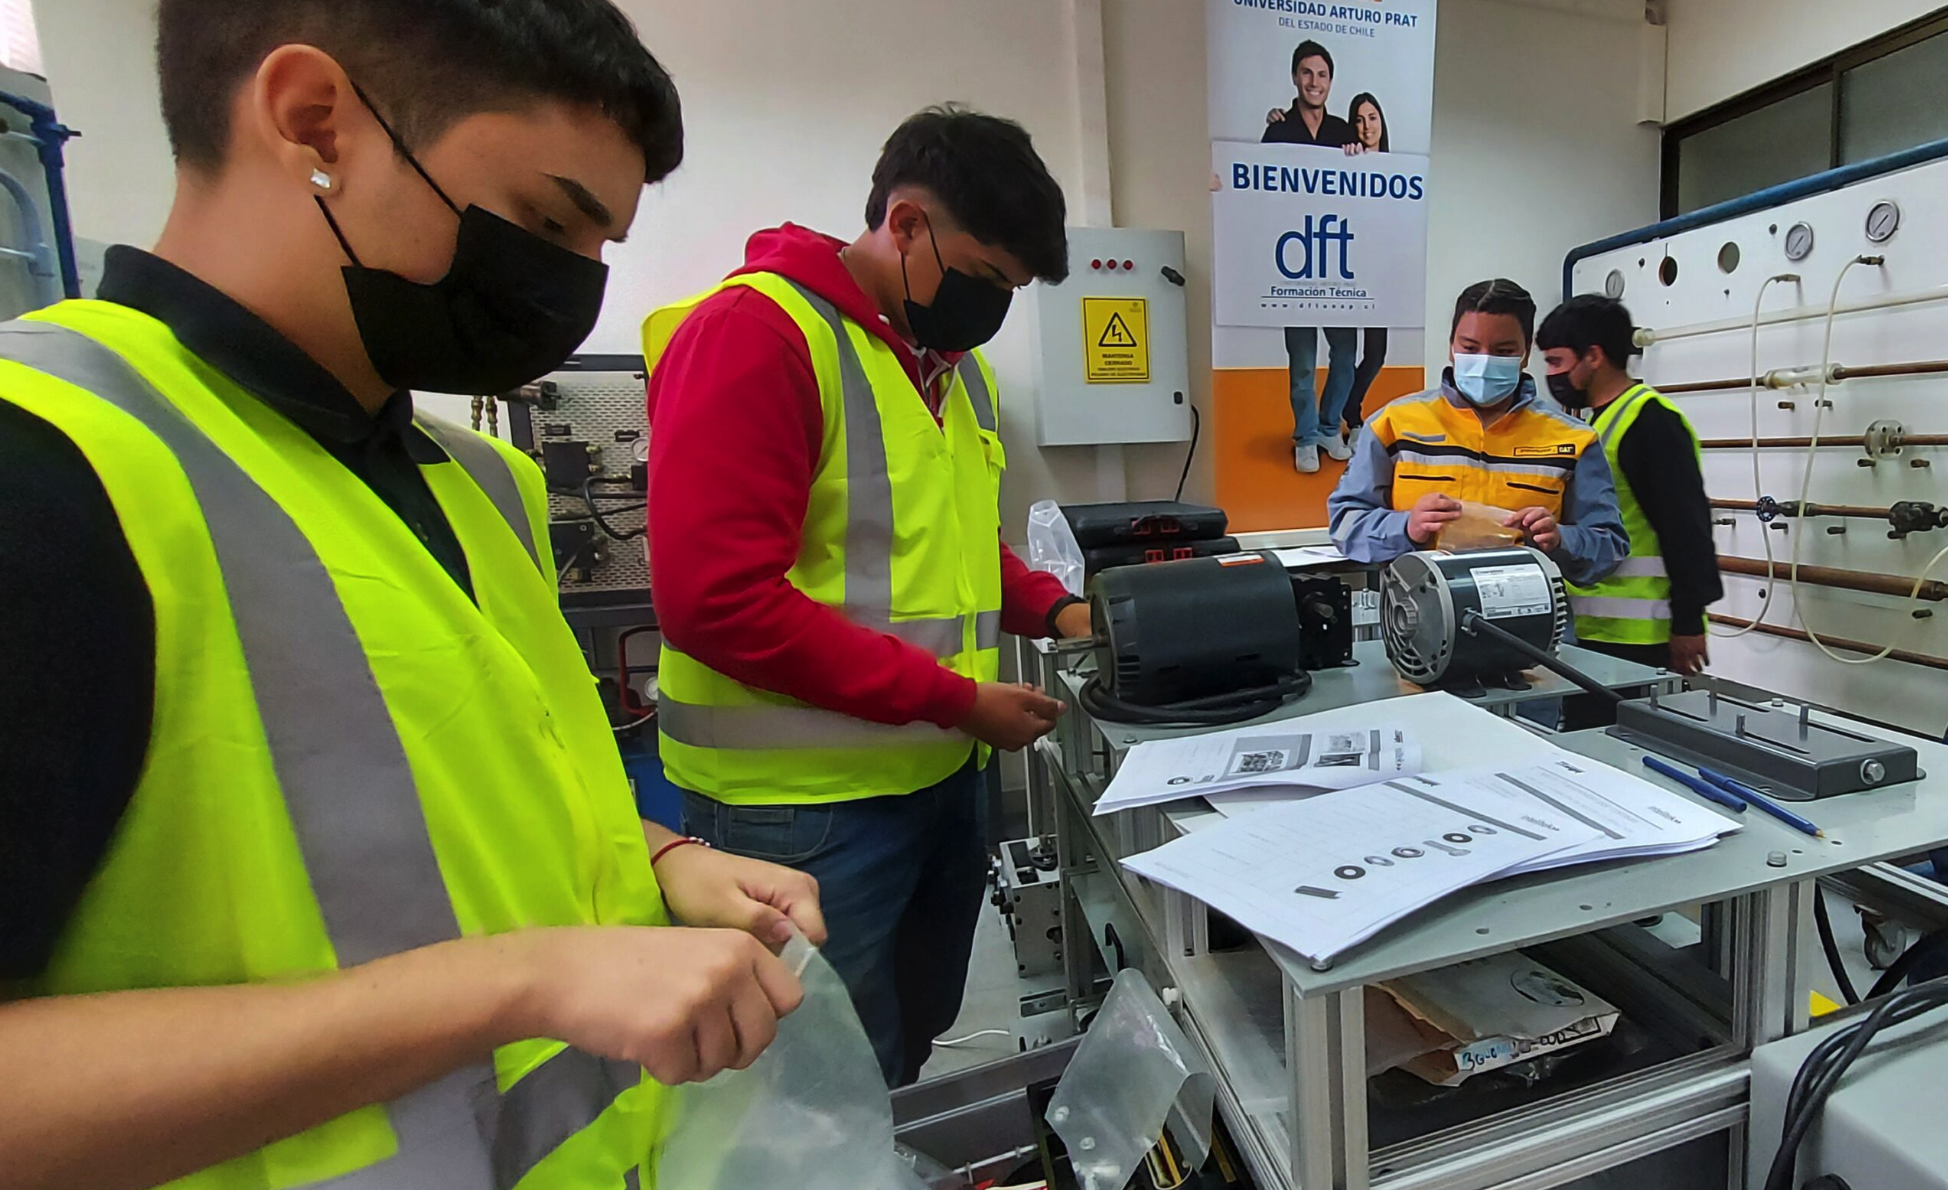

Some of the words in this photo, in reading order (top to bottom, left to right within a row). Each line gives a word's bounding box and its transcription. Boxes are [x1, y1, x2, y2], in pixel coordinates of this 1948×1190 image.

[1278, 17, 1295, 28] DEL
[1298, 19, 1333, 33] ESTADO
[1336, 24, 1347, 34] DE
[1349, 26, 1375, 38] CHILE
[1329, 5, 1381, 24] ARTURO
[1385, 12, 1418, 28] PRAT
[1232, 163, 1423, 200] BIENVENIDOS
[1275, 214, 1354, 280] dft
[1270, 286, 1326, 297] Formación
[1329, 287, 1367, 298] Técnica
